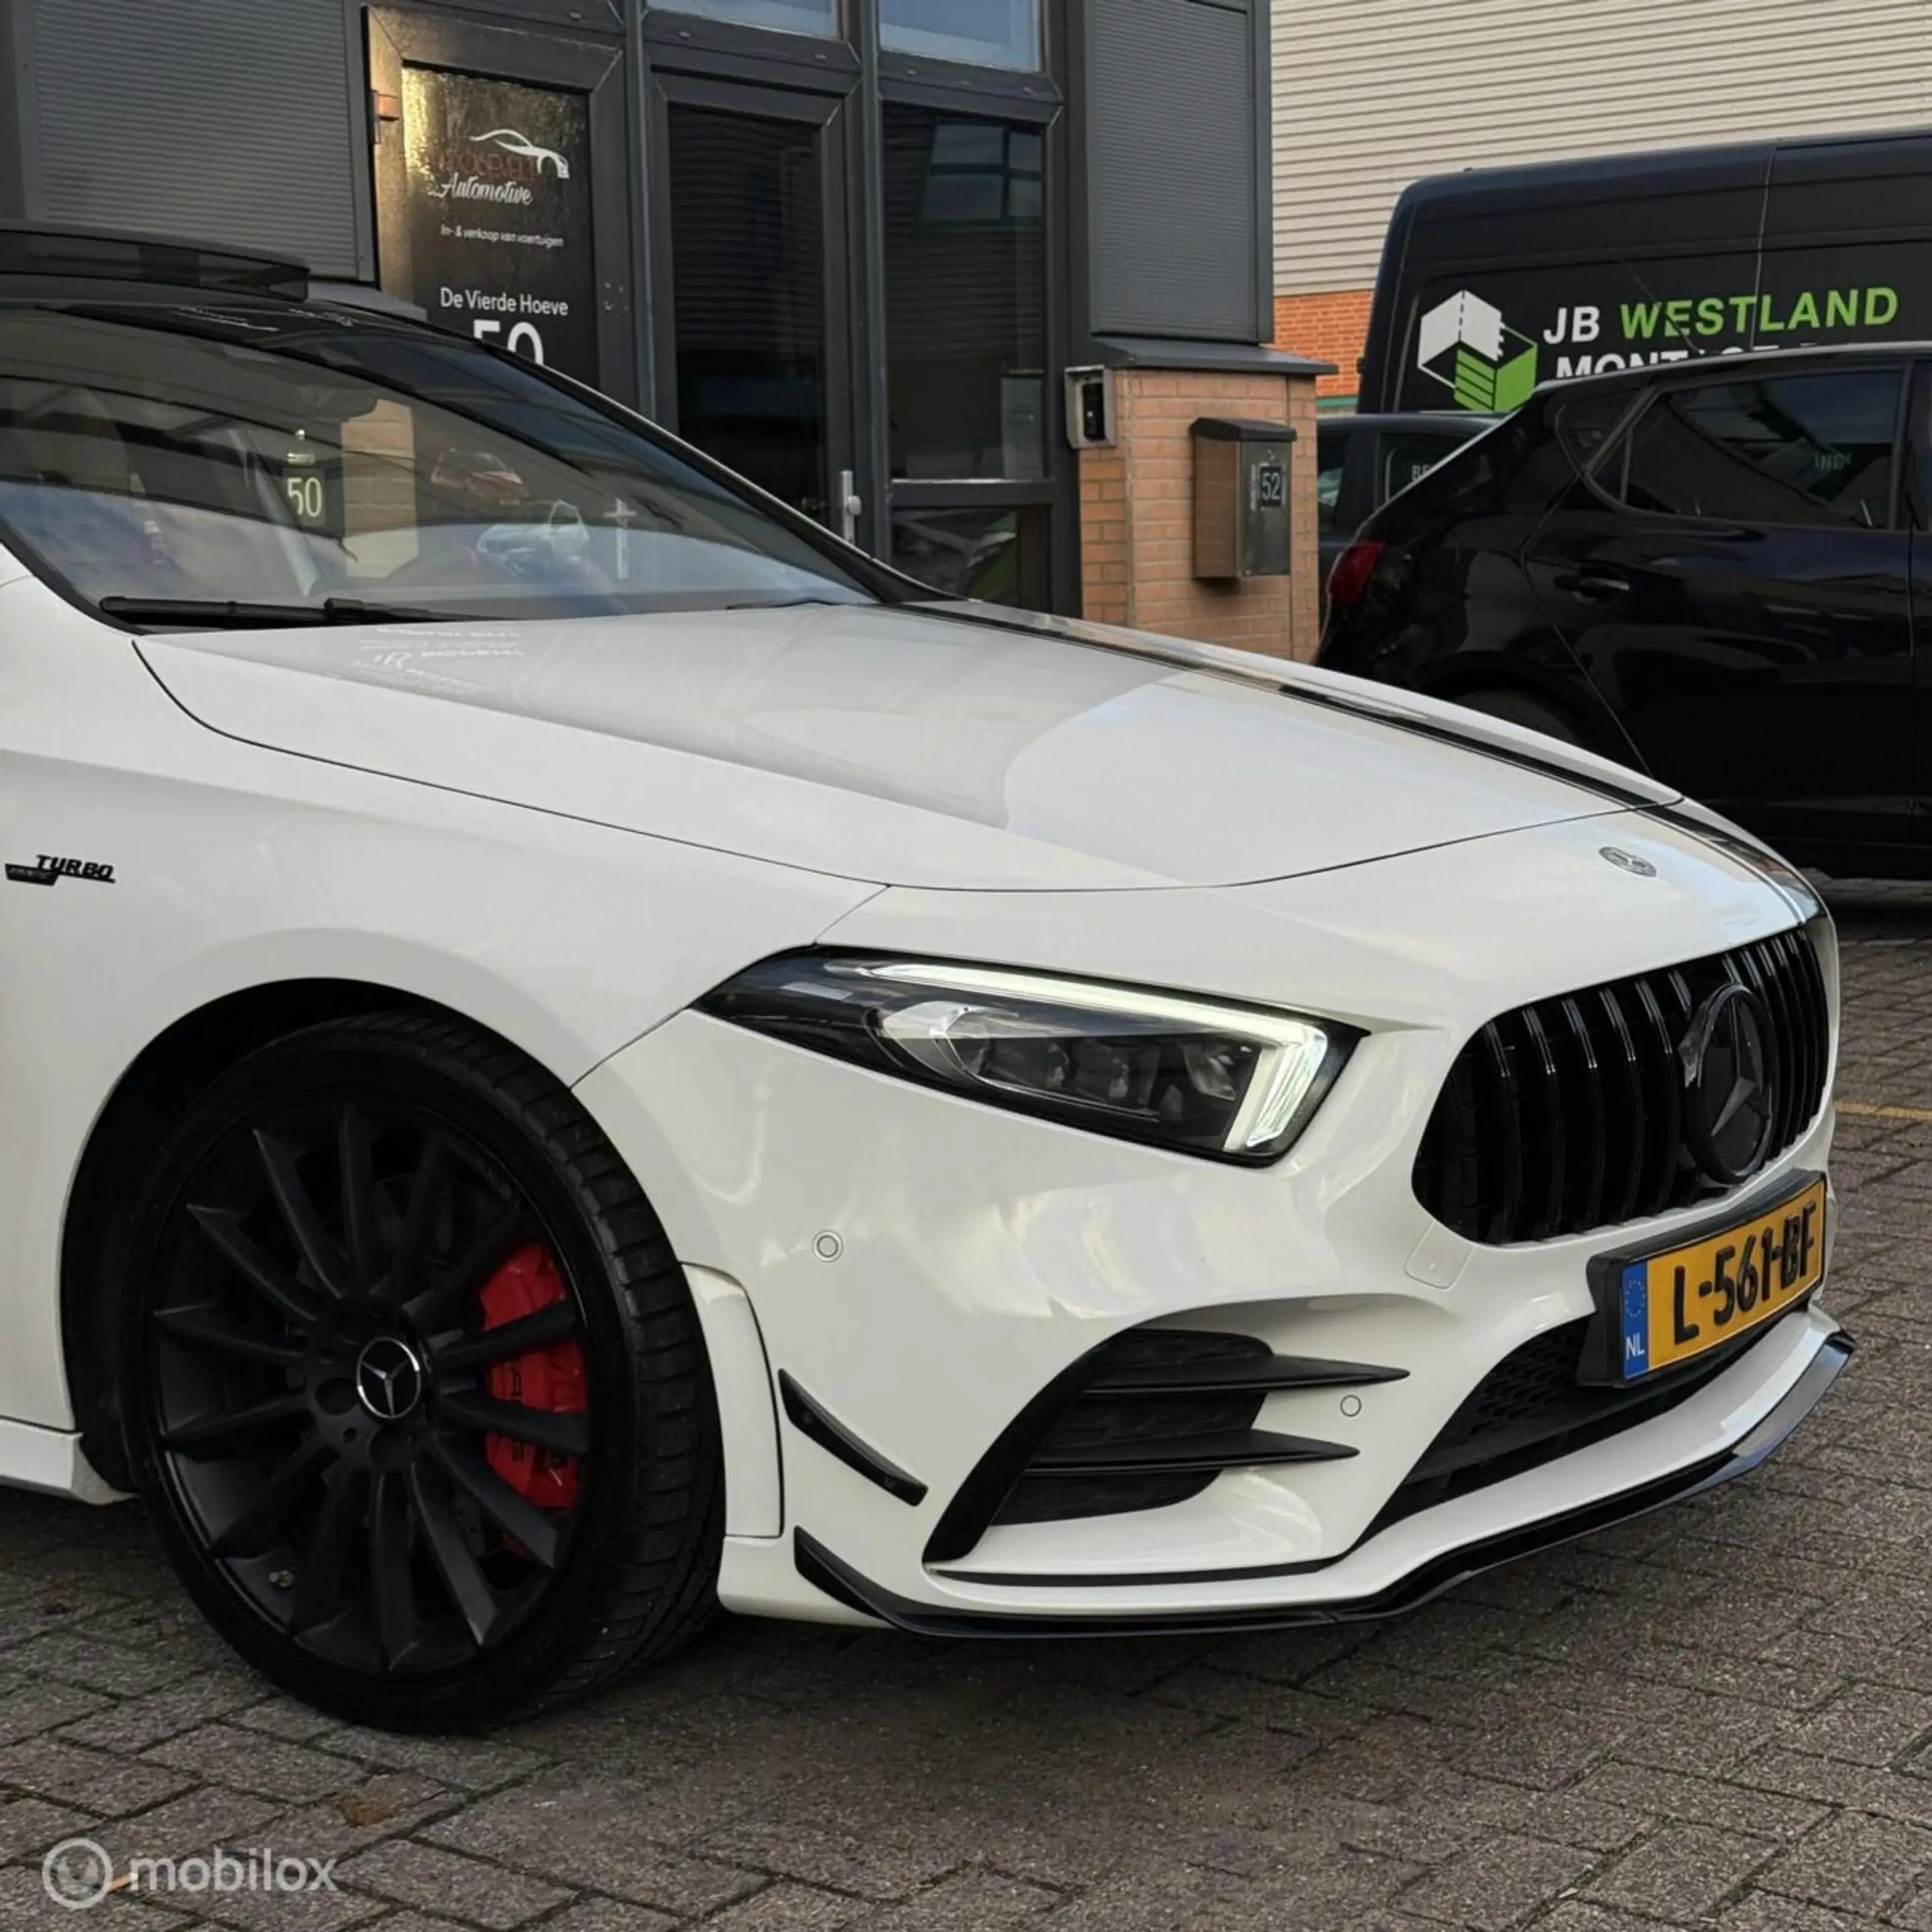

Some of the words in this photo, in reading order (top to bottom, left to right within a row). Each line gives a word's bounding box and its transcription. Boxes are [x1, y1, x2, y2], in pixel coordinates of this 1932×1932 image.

[431, 172, 533, 205] Automotive
[463, 227, 498, 243] verkoop
[440, 286, 463, 309] De
[465, 289, 517, 312] Vierde
[519, 292, 569, 316] Hoeve
[1543, 306, 1601, 344] JB
[1620, 287, 1898, 339] WESTLAND
[287, 477, 322, 519] 50
[1262, 472, 1281, 500] 52
[36, 854, 115, 882] TURBO
[1625, 1332, 1646, 1360] NL
[1673, 1199, 1817, 1346] L-561-BF
